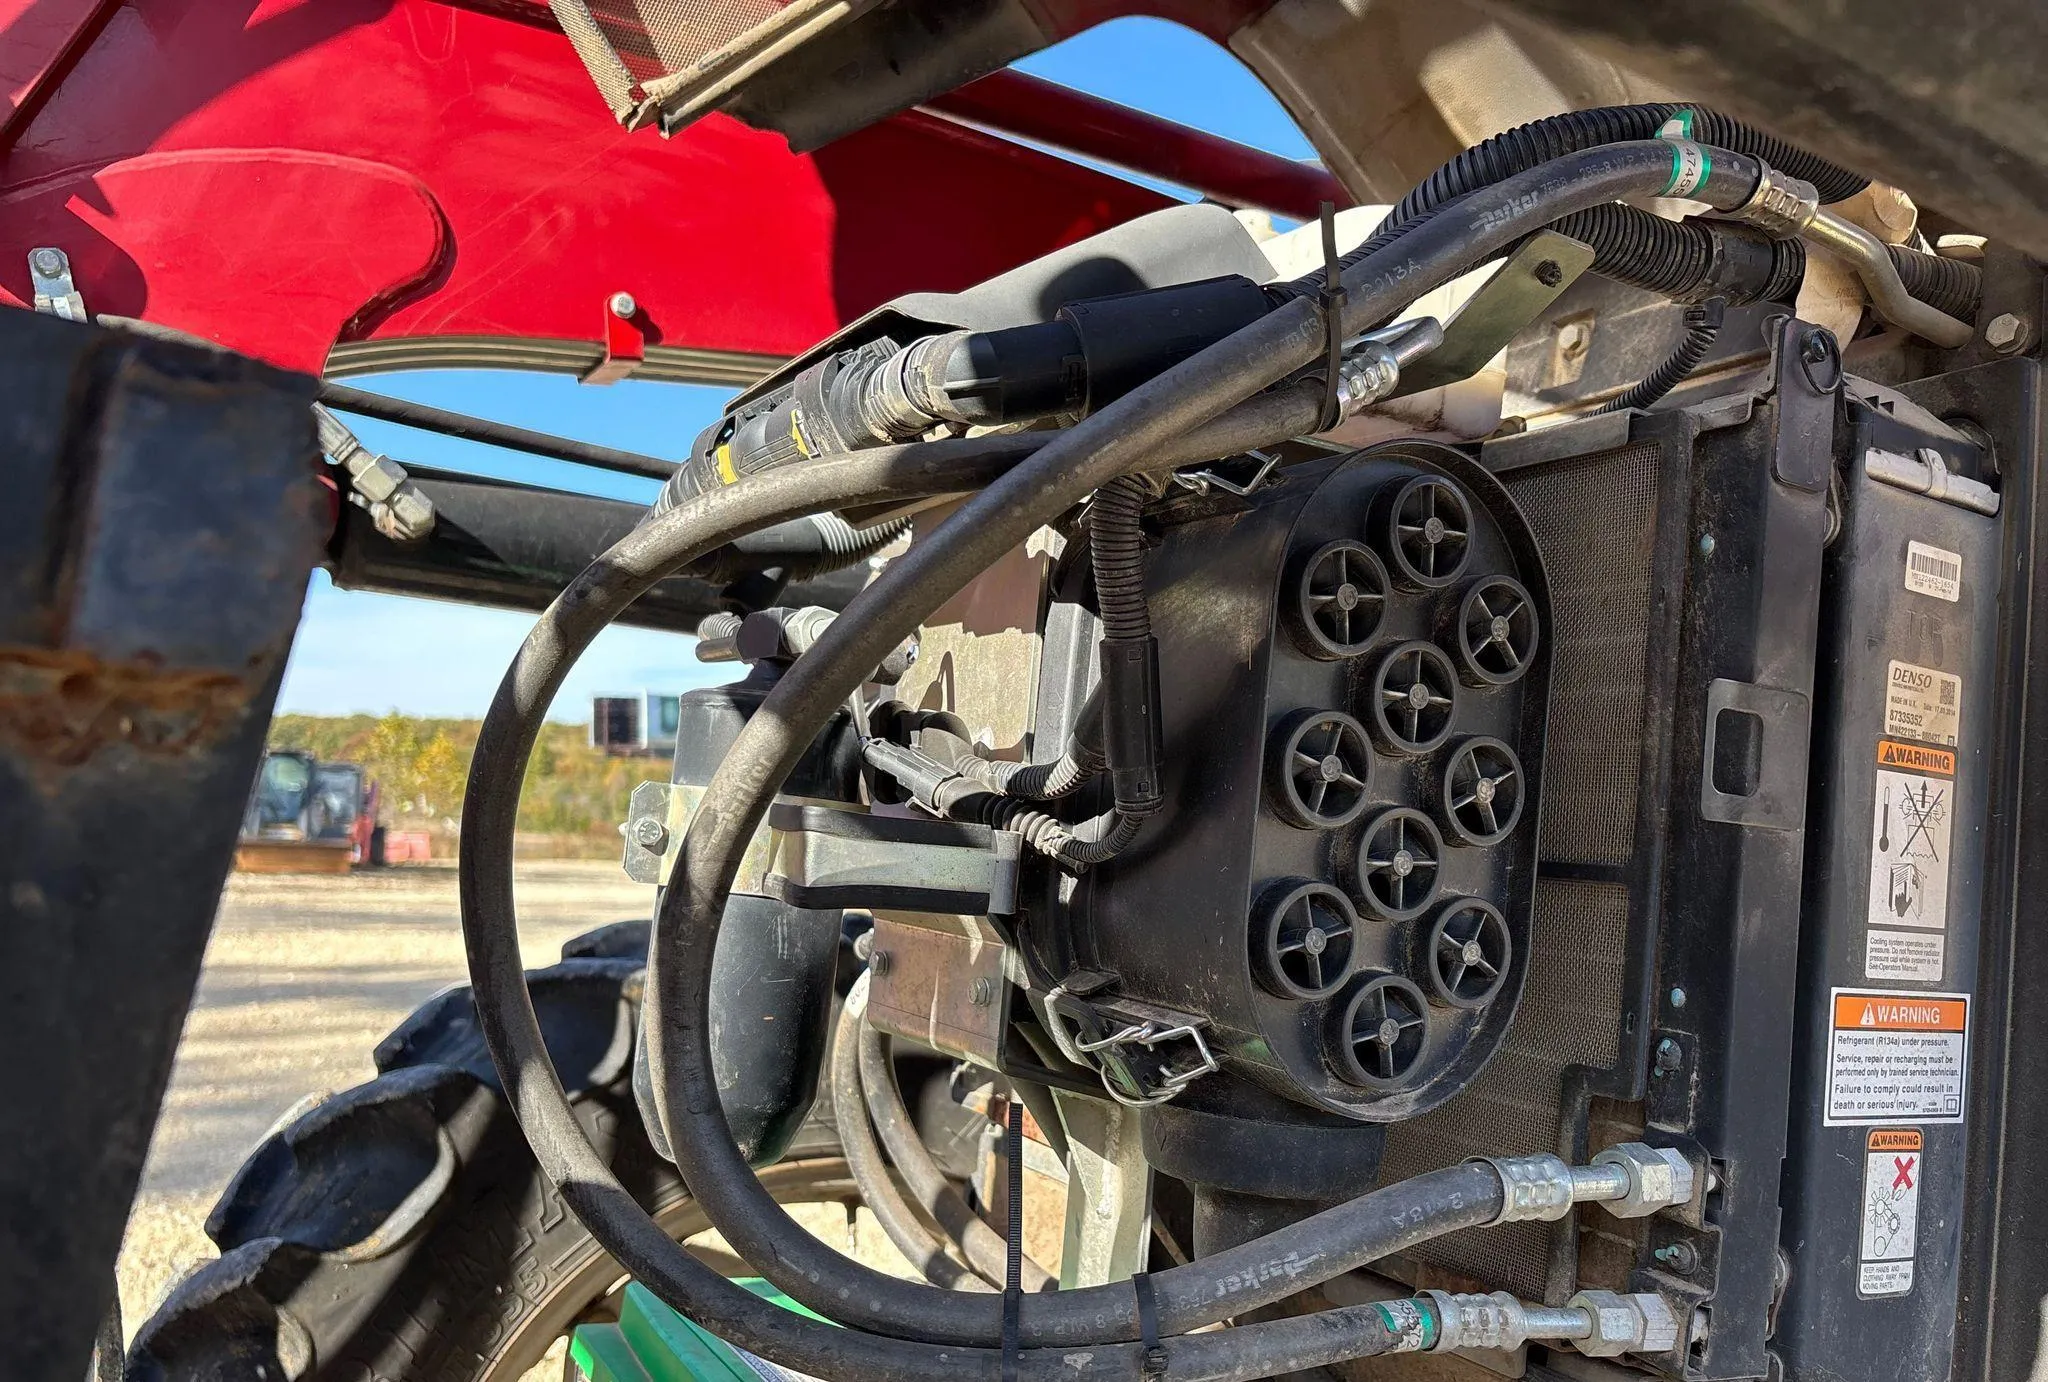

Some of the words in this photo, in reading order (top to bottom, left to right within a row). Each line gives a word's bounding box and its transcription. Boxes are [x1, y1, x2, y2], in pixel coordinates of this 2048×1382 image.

[1893, 667, 1932, 688] DENSO
[1889, 709, 1923, 727] 87335352
[1896, 748, 1950, 770] WARNING
[1870, 937, 1887, 947] Cooling
[1888, 939, 1904, 947] system
[1877, 1005, 1940, 1024] WARNING
[1838, 1036, 1875, 1047] Refrigerant
[1876, 1036, 1900, 1047] (R134a)
[1901, 1038, 1920, 1046] under
[1921, 1039, 1950, 1048] pressure.
[1836, 1054, 1863, 1064] Service,
[1865, 1055, 1884, 1065] repair
[1894, 1055, 1927, 1065] recharging
[1929, 1056, 1944, 1064] must
[1945, 1055, 1953, 1063] be
[1835, 1068, 1865, 1078] performed
[1867, 1068, 1879, 1078] only
[1881, 1068, 1887, 1078] by
[1889, 1068, 1908, 1076] trained
[1909, 1068, 1928, 1076] service
[1930, 1068, 1959, 1077] technician.
[1835, 1084, 1861, 1093] Failure
[1864, 1085, 1871, 1093] to
[1873, 1084, 1900, 1096] comply
[1902, 1084, 1922, 1093] could
[1924, 1084, 1944, 1093] result
[1946, 1083, 1953, 1093] in
[1833, 1100, 1855, 1109] death
[1857, 1101, 1865, 1109] or
[1867, 1100, 1894, 1109] serious
[1896, 1099, 1918, 1111] injury.
[1881, 1135, 1919, 1146] WARNING
[1875, 1265, 1890, 1273] HANDS
[1863, 1274, 1884, 1282] CLOTHING
[1898, 1272, 1911, 1280] FROM
[1862, 1282, 1879, 1290] MOVING
